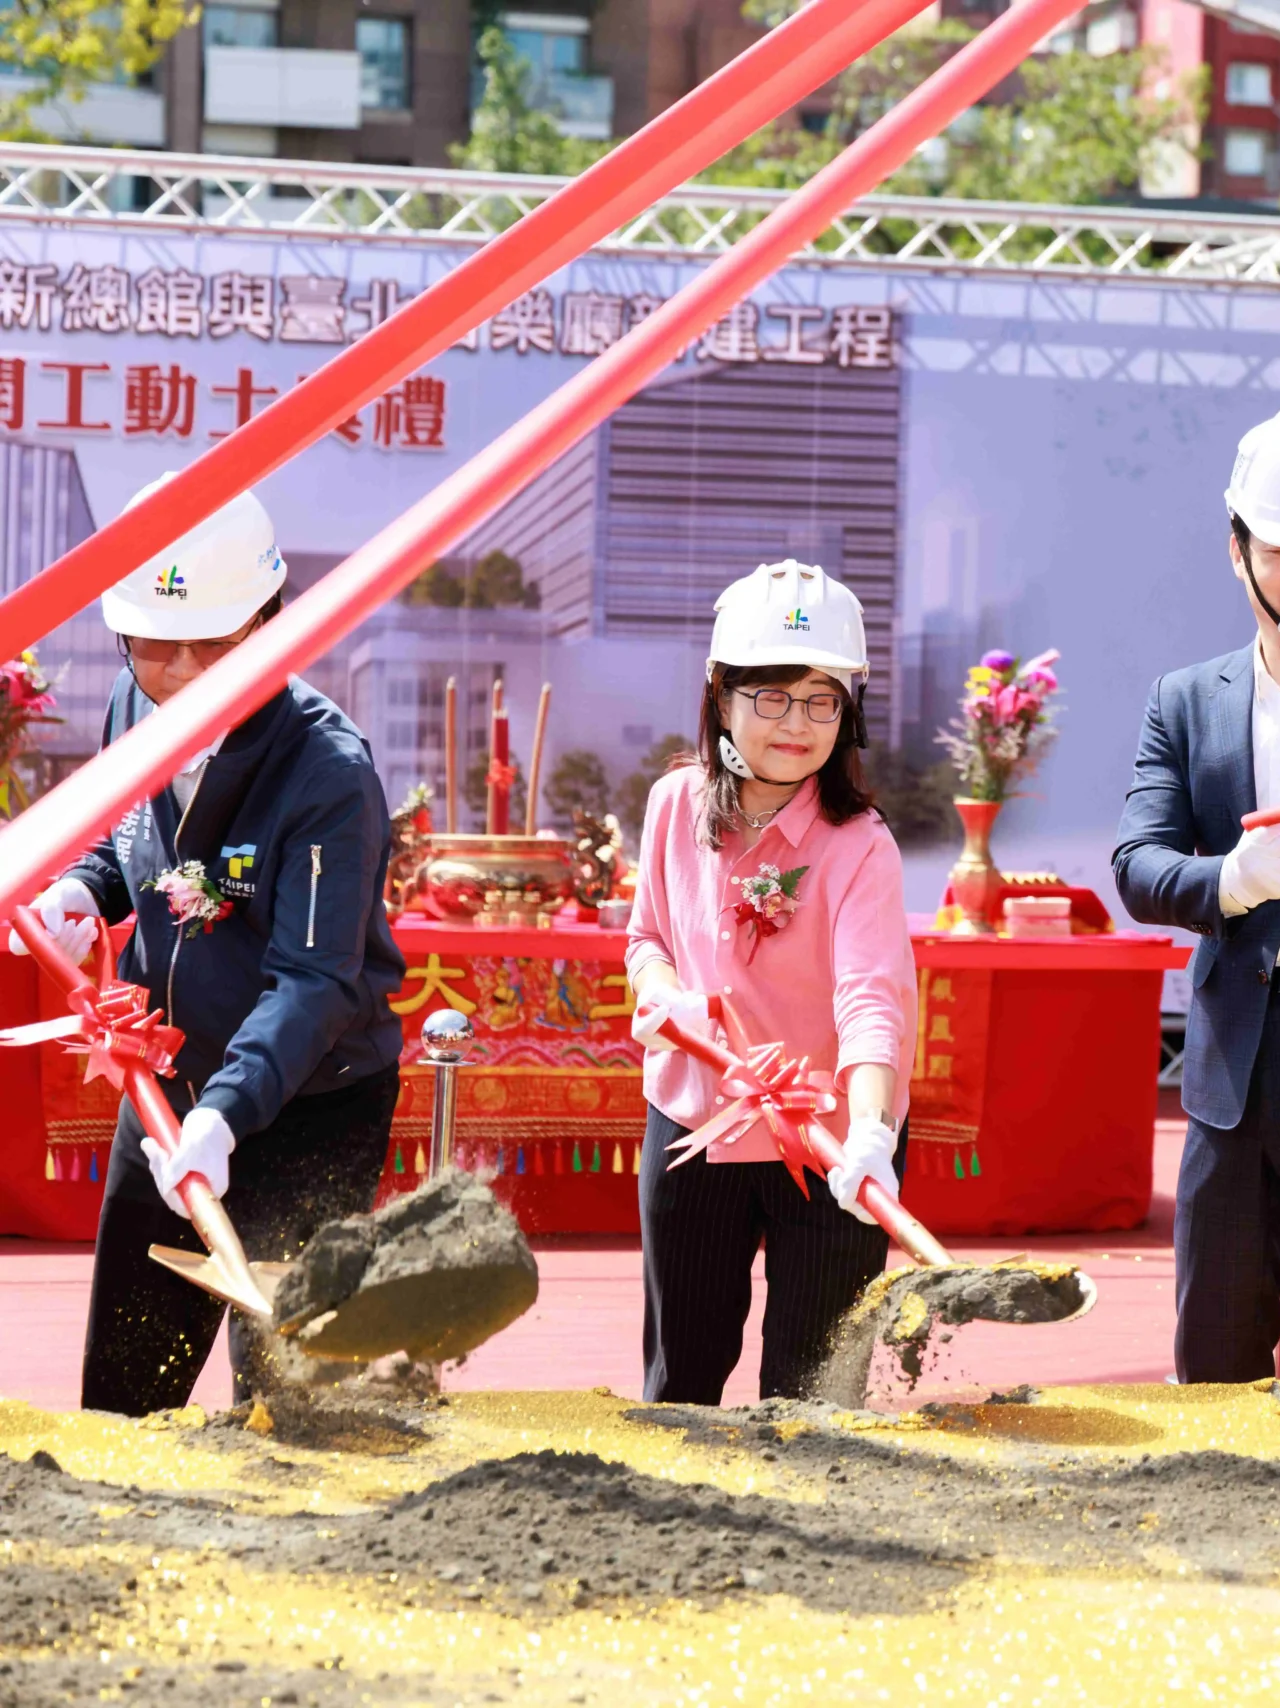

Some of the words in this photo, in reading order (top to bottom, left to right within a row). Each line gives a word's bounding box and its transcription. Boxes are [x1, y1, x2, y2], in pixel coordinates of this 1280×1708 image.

[0, 357, 446, 448] 工動土禮
[154, 587, 187, 597] TAIPEI
[218, 878, 256, 893] TAIPEI
